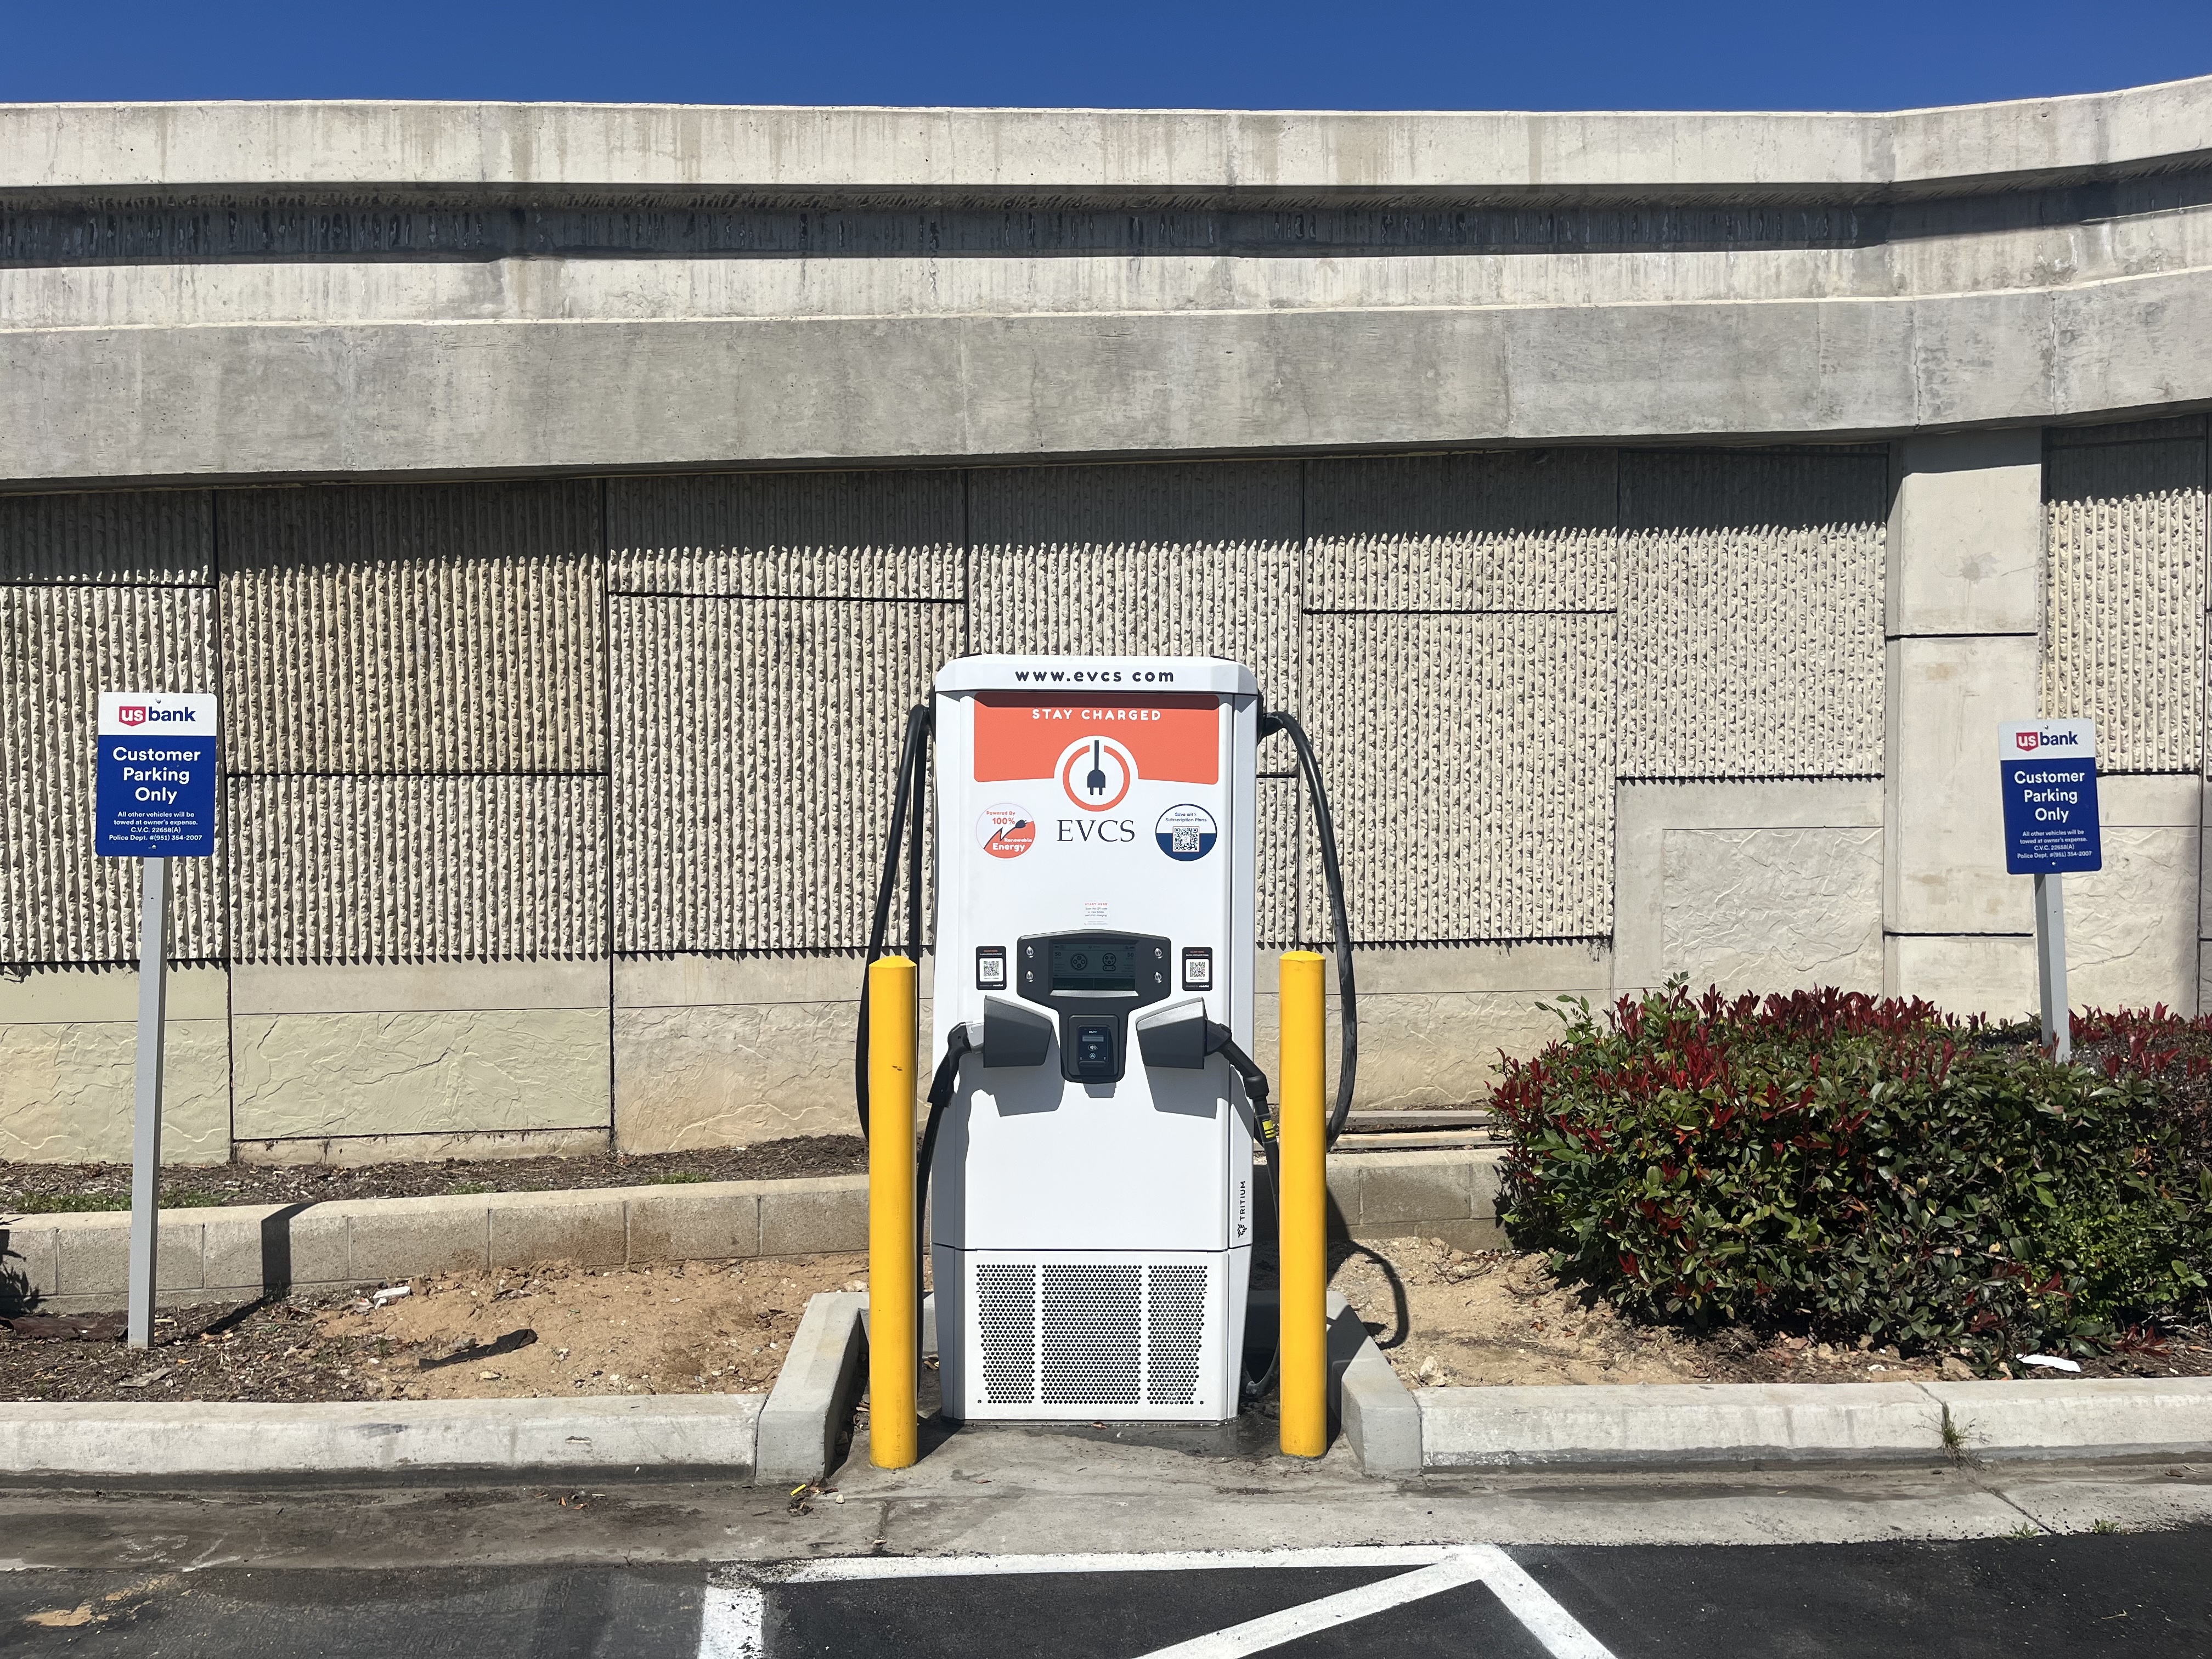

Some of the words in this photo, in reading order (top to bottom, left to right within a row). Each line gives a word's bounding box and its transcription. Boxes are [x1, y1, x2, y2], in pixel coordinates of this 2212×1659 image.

[1032, 709, 1072, 720] STAY
[1081, 709, 1162, 721] CHARGED
[113, 747, 201, 761] Customer
[123, 767, 189, 785] Parking
[2015, 771, 2085, 783] Customer
[135, 787, 177, 804] Only
[2024, 789, 2078, 804] Parking
[2035, 808, 2069, 823] Only
[1057, 819, 1135, 842] EVCS
[992, 843, 1025, 852] Energy
